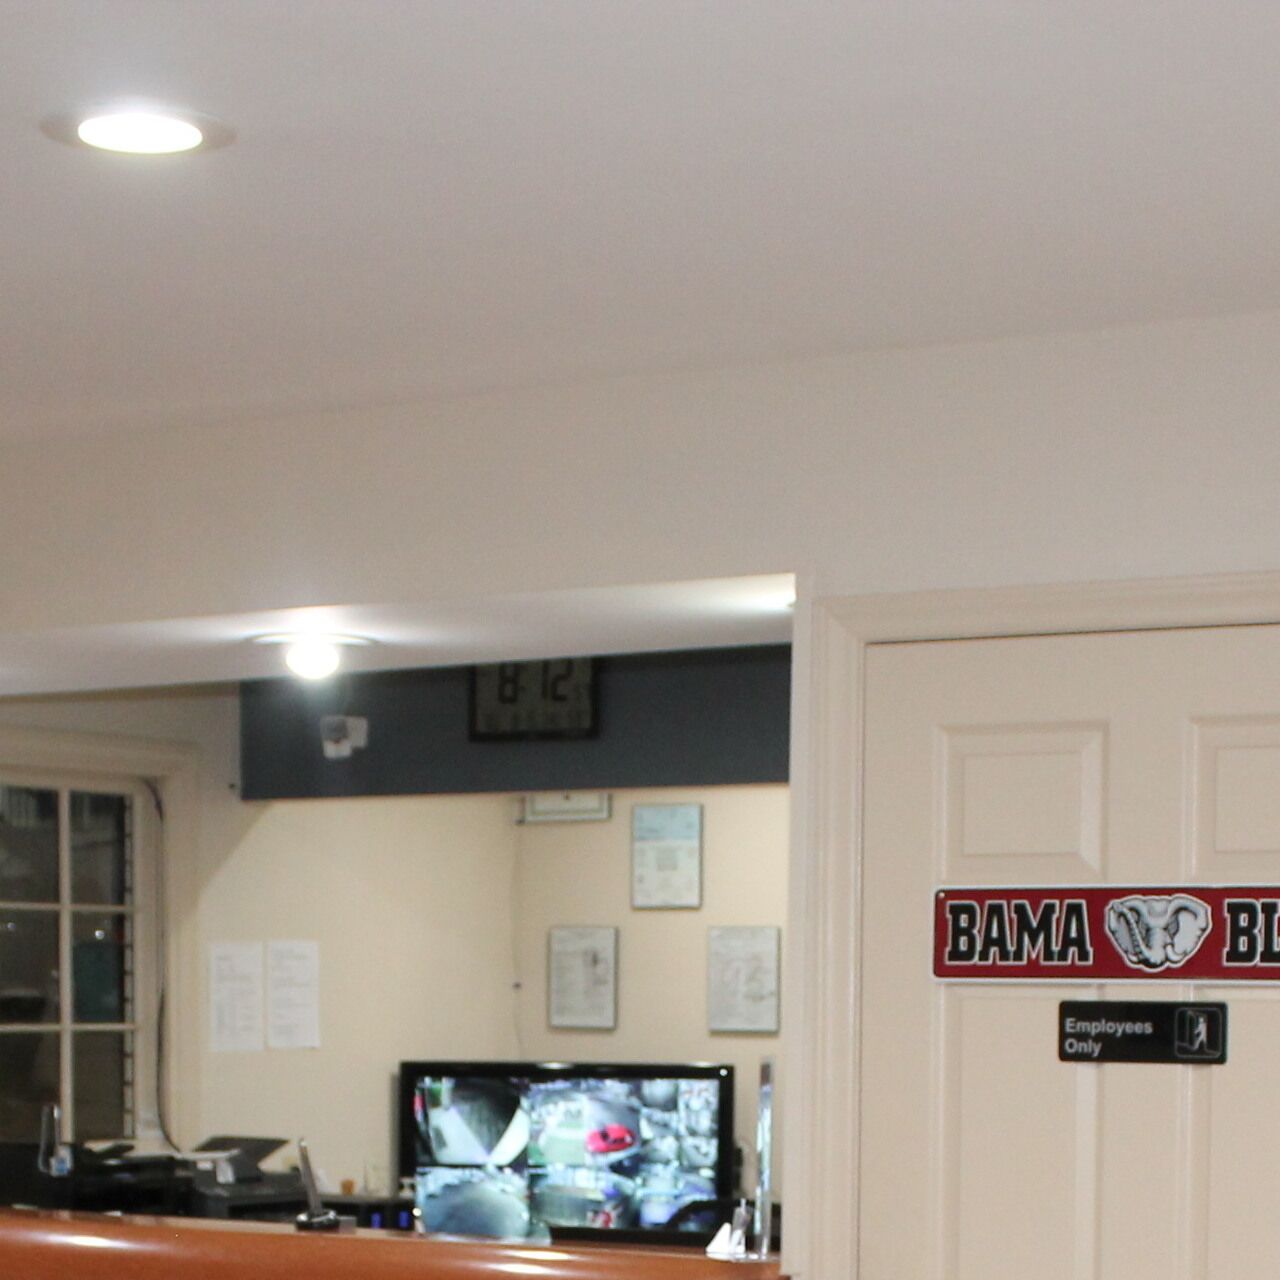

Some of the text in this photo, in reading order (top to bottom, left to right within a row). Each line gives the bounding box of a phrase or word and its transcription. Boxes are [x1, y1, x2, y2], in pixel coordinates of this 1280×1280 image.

[944, 899, 1093, 966] BAMA
[1064, 1017, 1153, 1036] Employees
[1064, 1038, 1103, 1057] Only
